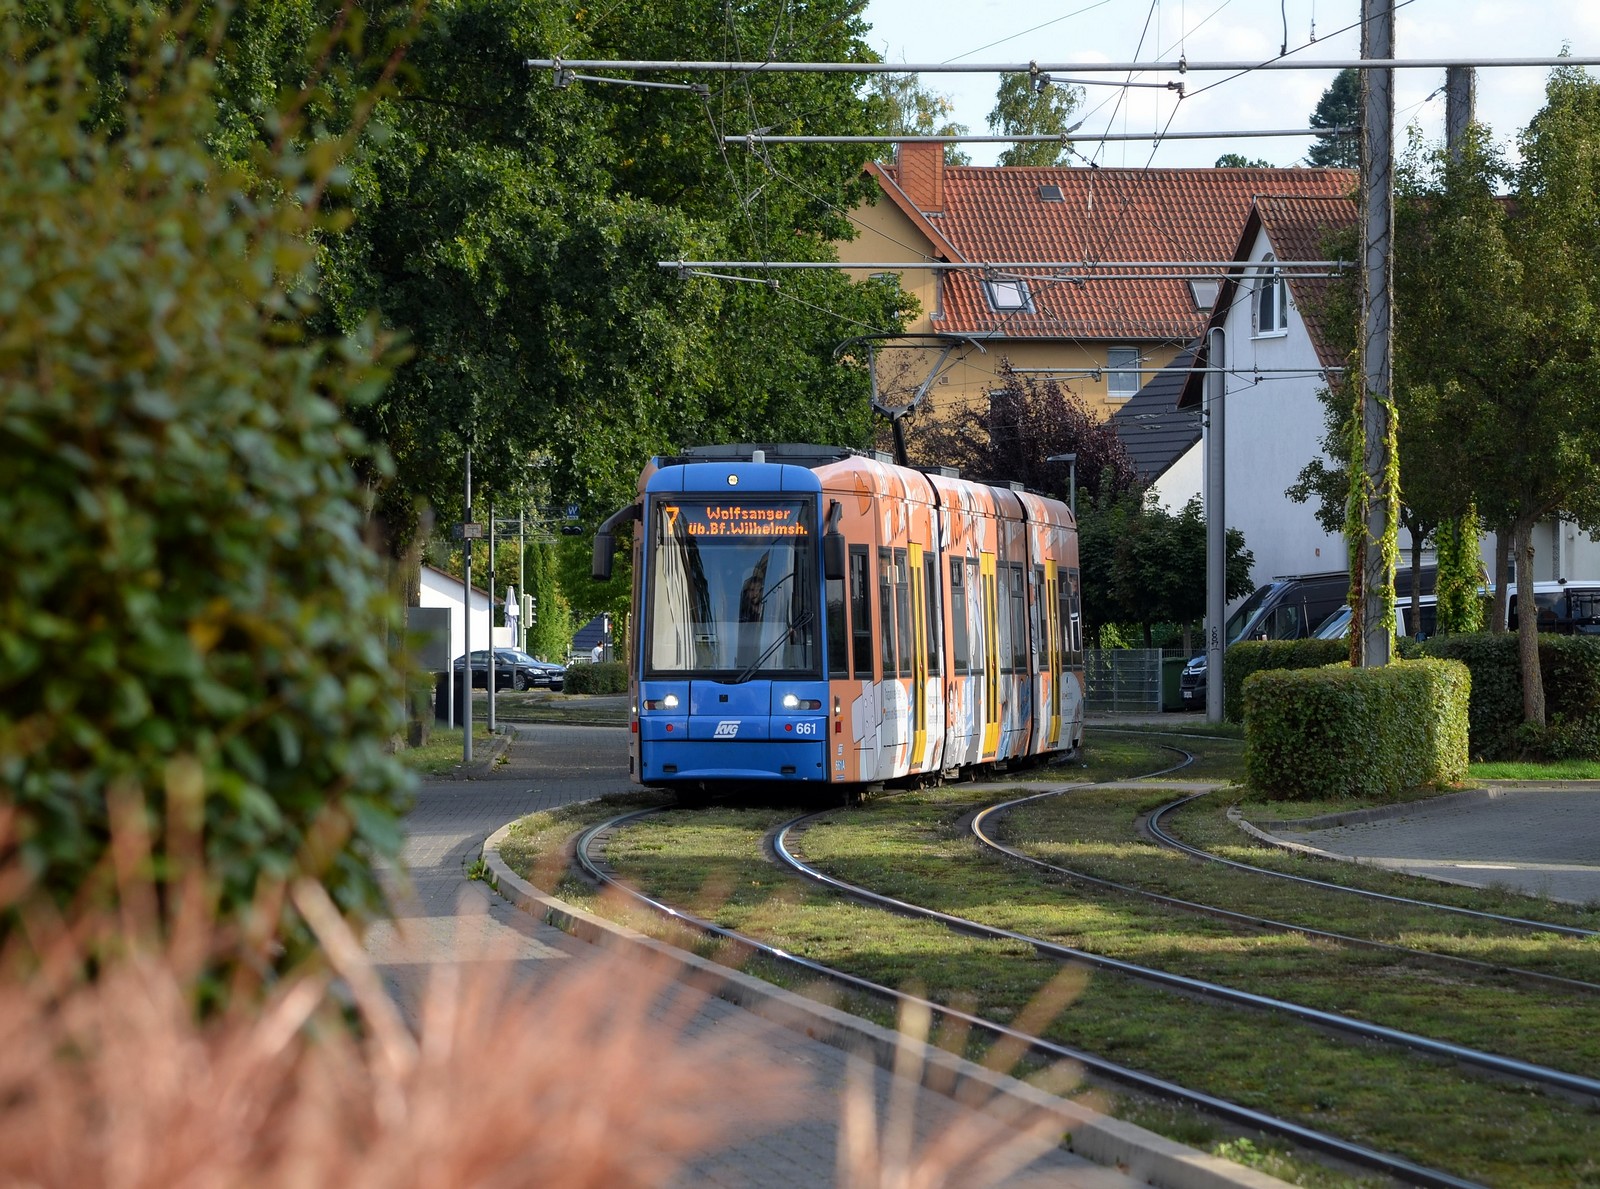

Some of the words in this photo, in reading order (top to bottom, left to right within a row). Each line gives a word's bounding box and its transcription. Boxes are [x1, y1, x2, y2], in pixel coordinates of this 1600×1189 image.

[568, 506, 578, 515] W
[706, 506, 791, 520] Wolfsanger
[665, 506, 680, 535] 7
[714, 721, 740, 737] KVG
[796, 723, 816, 735] 661
